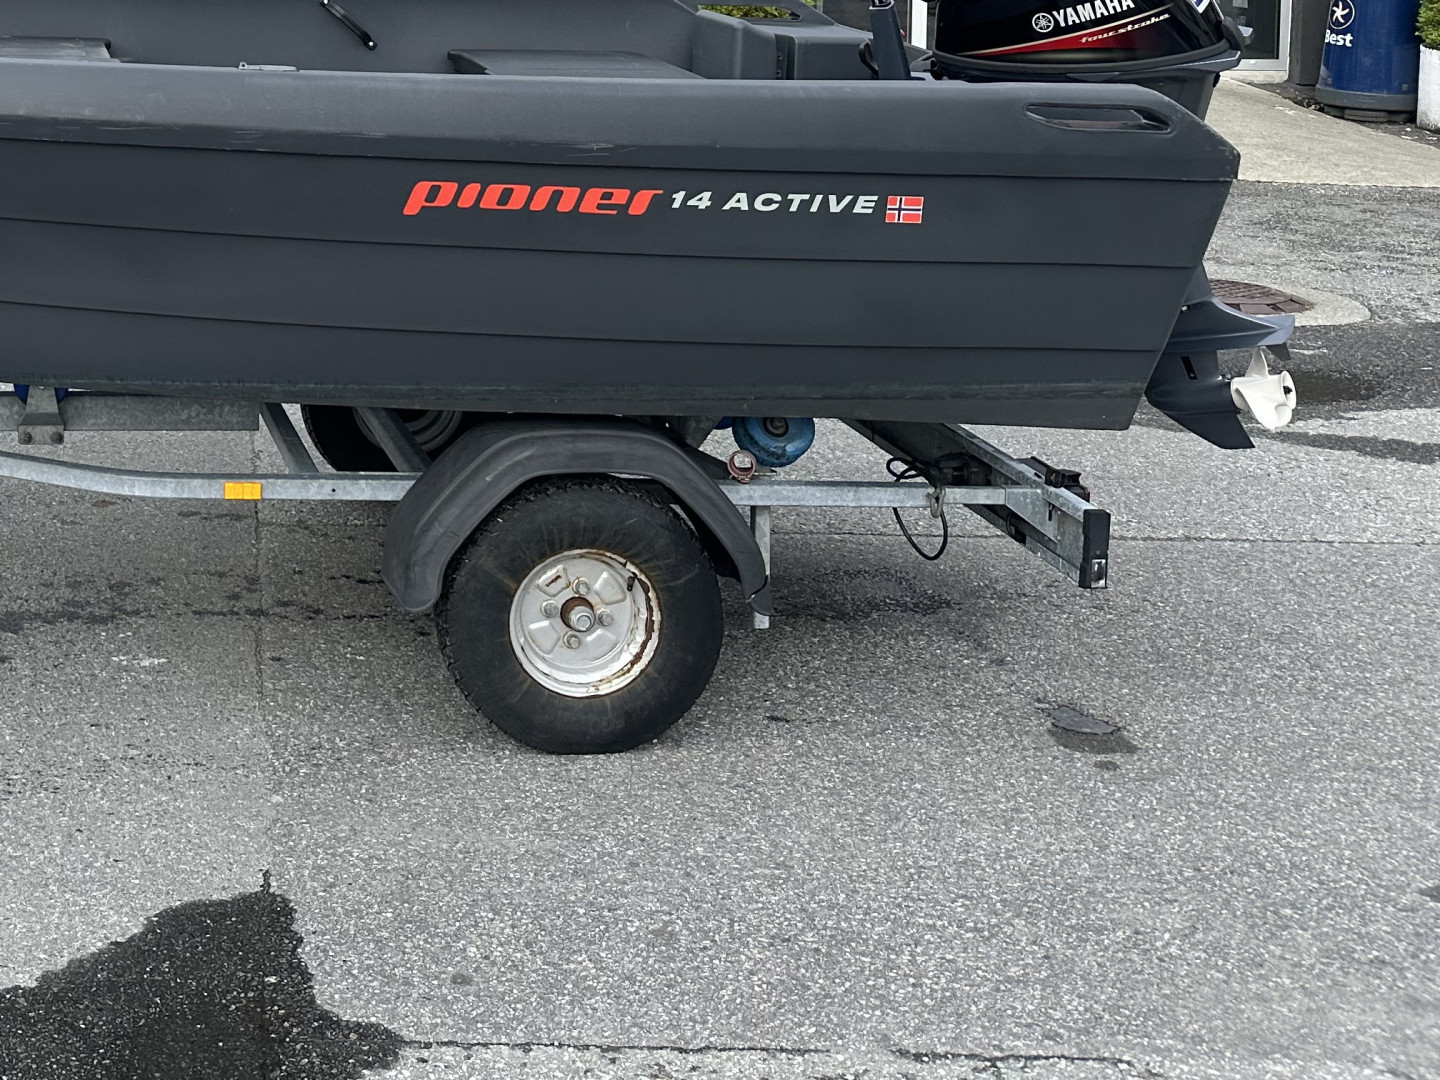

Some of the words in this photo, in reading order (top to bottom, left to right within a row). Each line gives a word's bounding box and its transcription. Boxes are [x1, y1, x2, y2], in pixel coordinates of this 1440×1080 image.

[1325, 29, 1354, 47] Best
[402, 181, 664, 216] pioner
[671, 190, 712, 210] 14
[722, 192, 878, 214] ACTIVE
